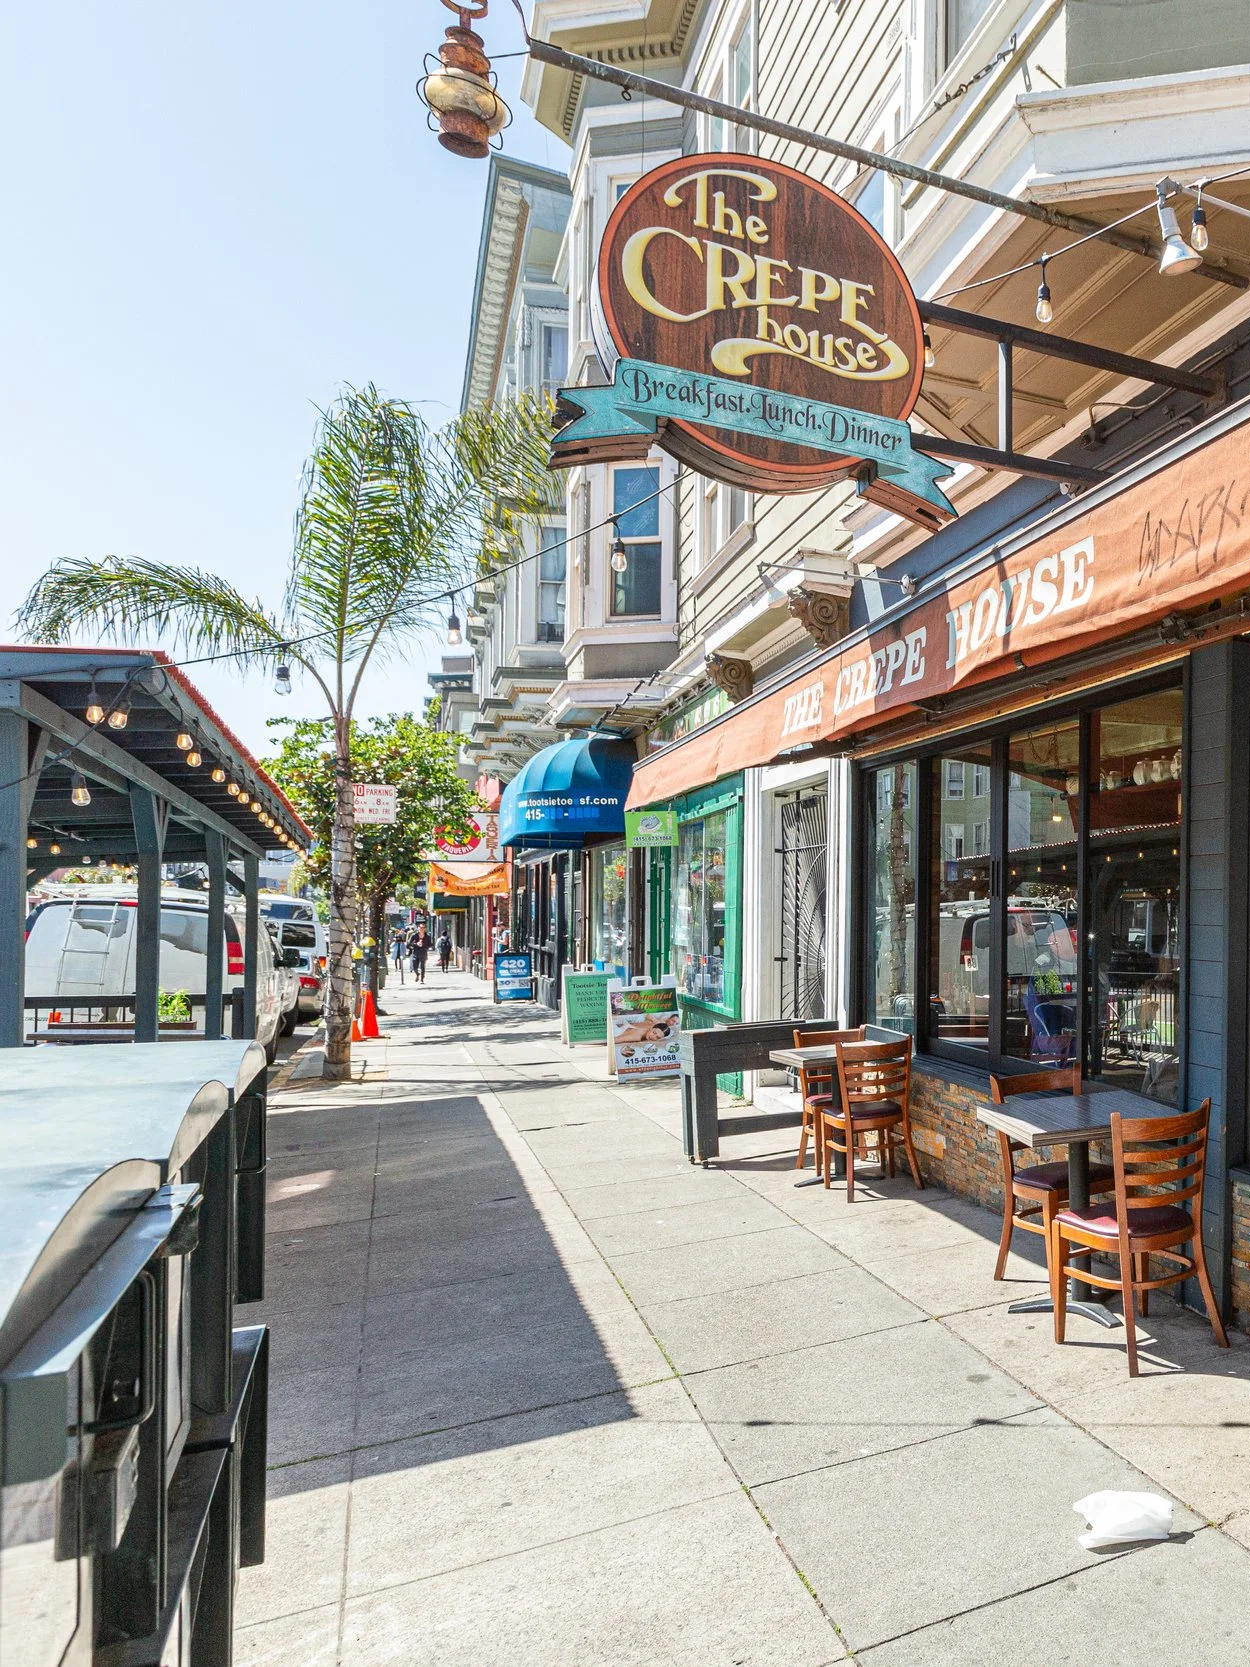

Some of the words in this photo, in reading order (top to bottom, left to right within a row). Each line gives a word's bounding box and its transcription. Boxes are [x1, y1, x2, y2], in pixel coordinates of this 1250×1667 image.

[664, 169, 777, 244] The
[621, 227, 888, 340] CREPE
[756, 305, 880, 372] house
[781, 681, 825, 738] THE
[833, 626, 927, 716] CREPE
[944, 535, 1097, 671] HOUSE
[366, 788, 393, 796] PARKING
[441, 843, 474, 855] TAQUERIA
[500, 959, 526, 968] 420
[628, 992, 673, 1002] Delightful
[625, 1054, 677, 1065] 415-673-1068
